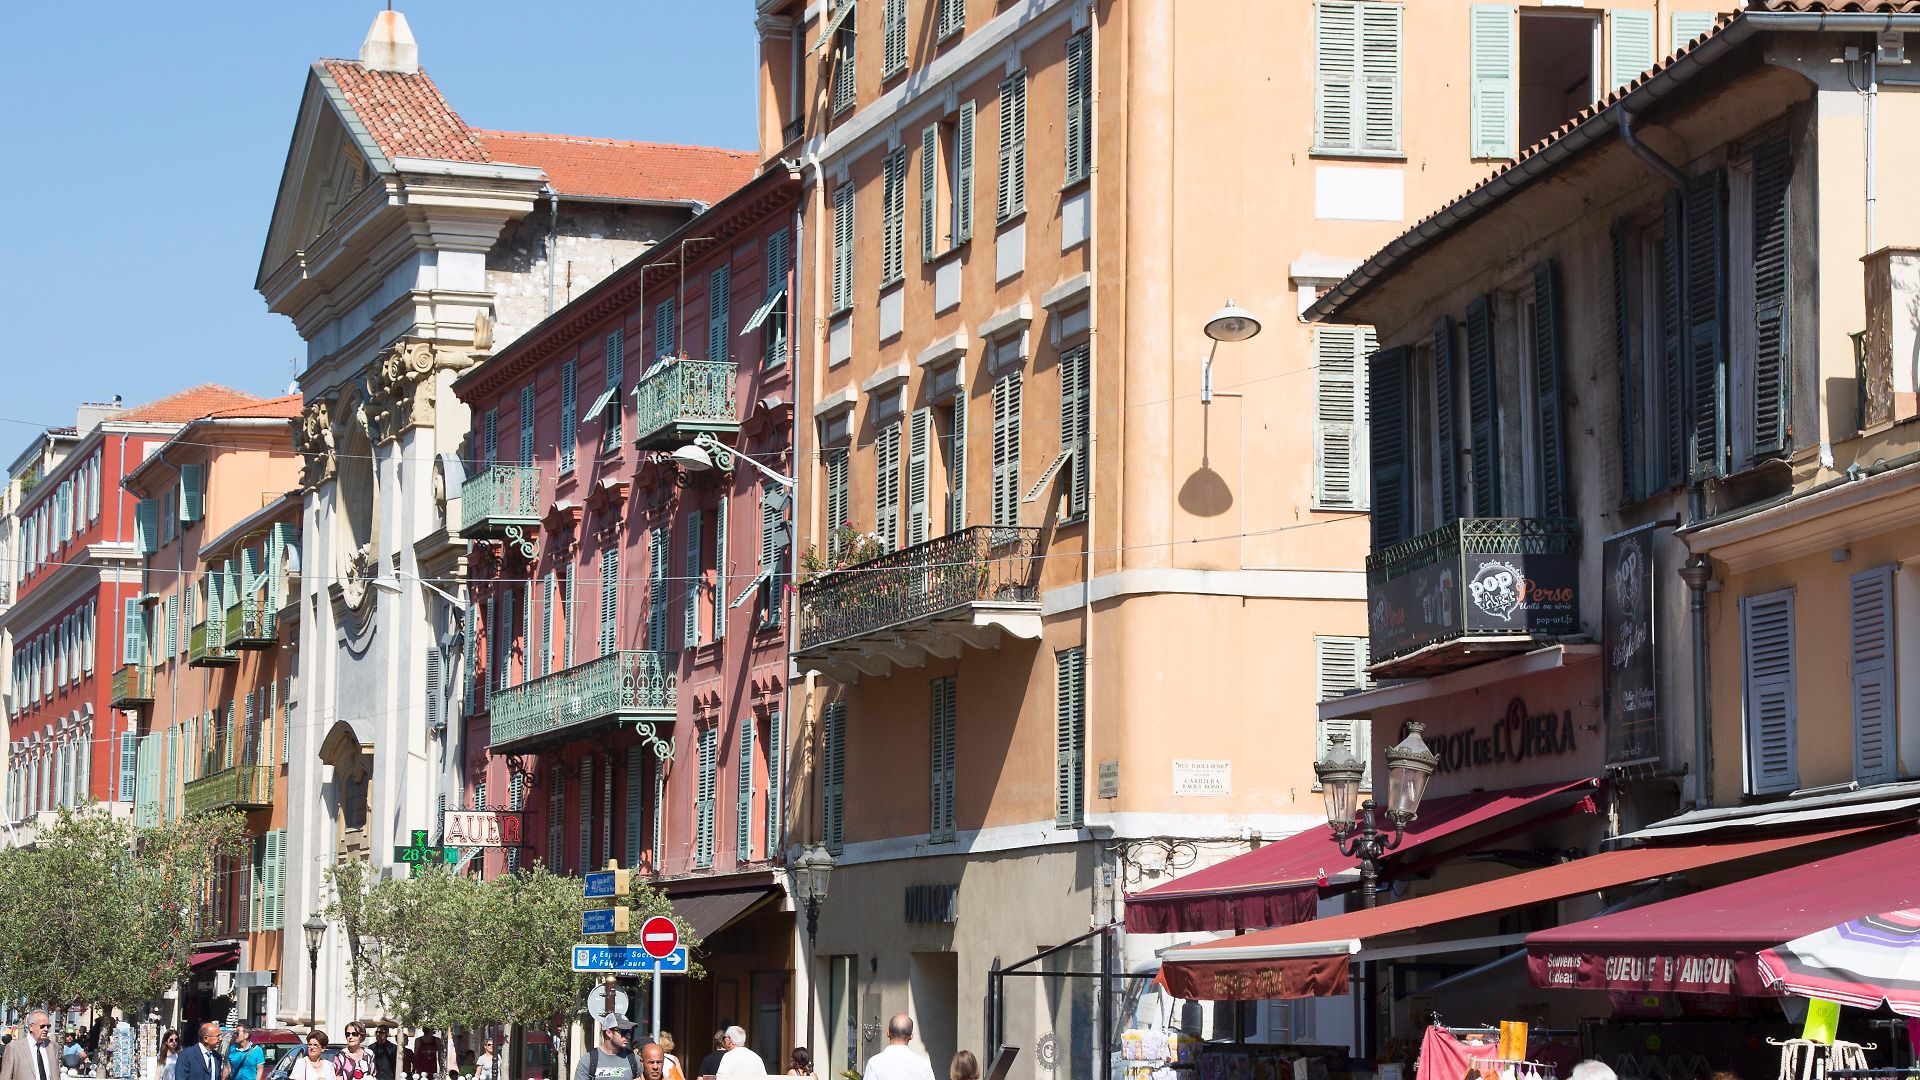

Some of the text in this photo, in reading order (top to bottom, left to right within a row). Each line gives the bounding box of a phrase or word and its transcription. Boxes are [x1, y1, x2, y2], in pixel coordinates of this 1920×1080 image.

[1469, 572, 1513, 606] POP
[1516, 578, 1574, 603] Perso
[446, 814, 520, 844] AUER
[600, 950, 627, 960] Espace
[1605, 957, 1657, 981] GUEULE
